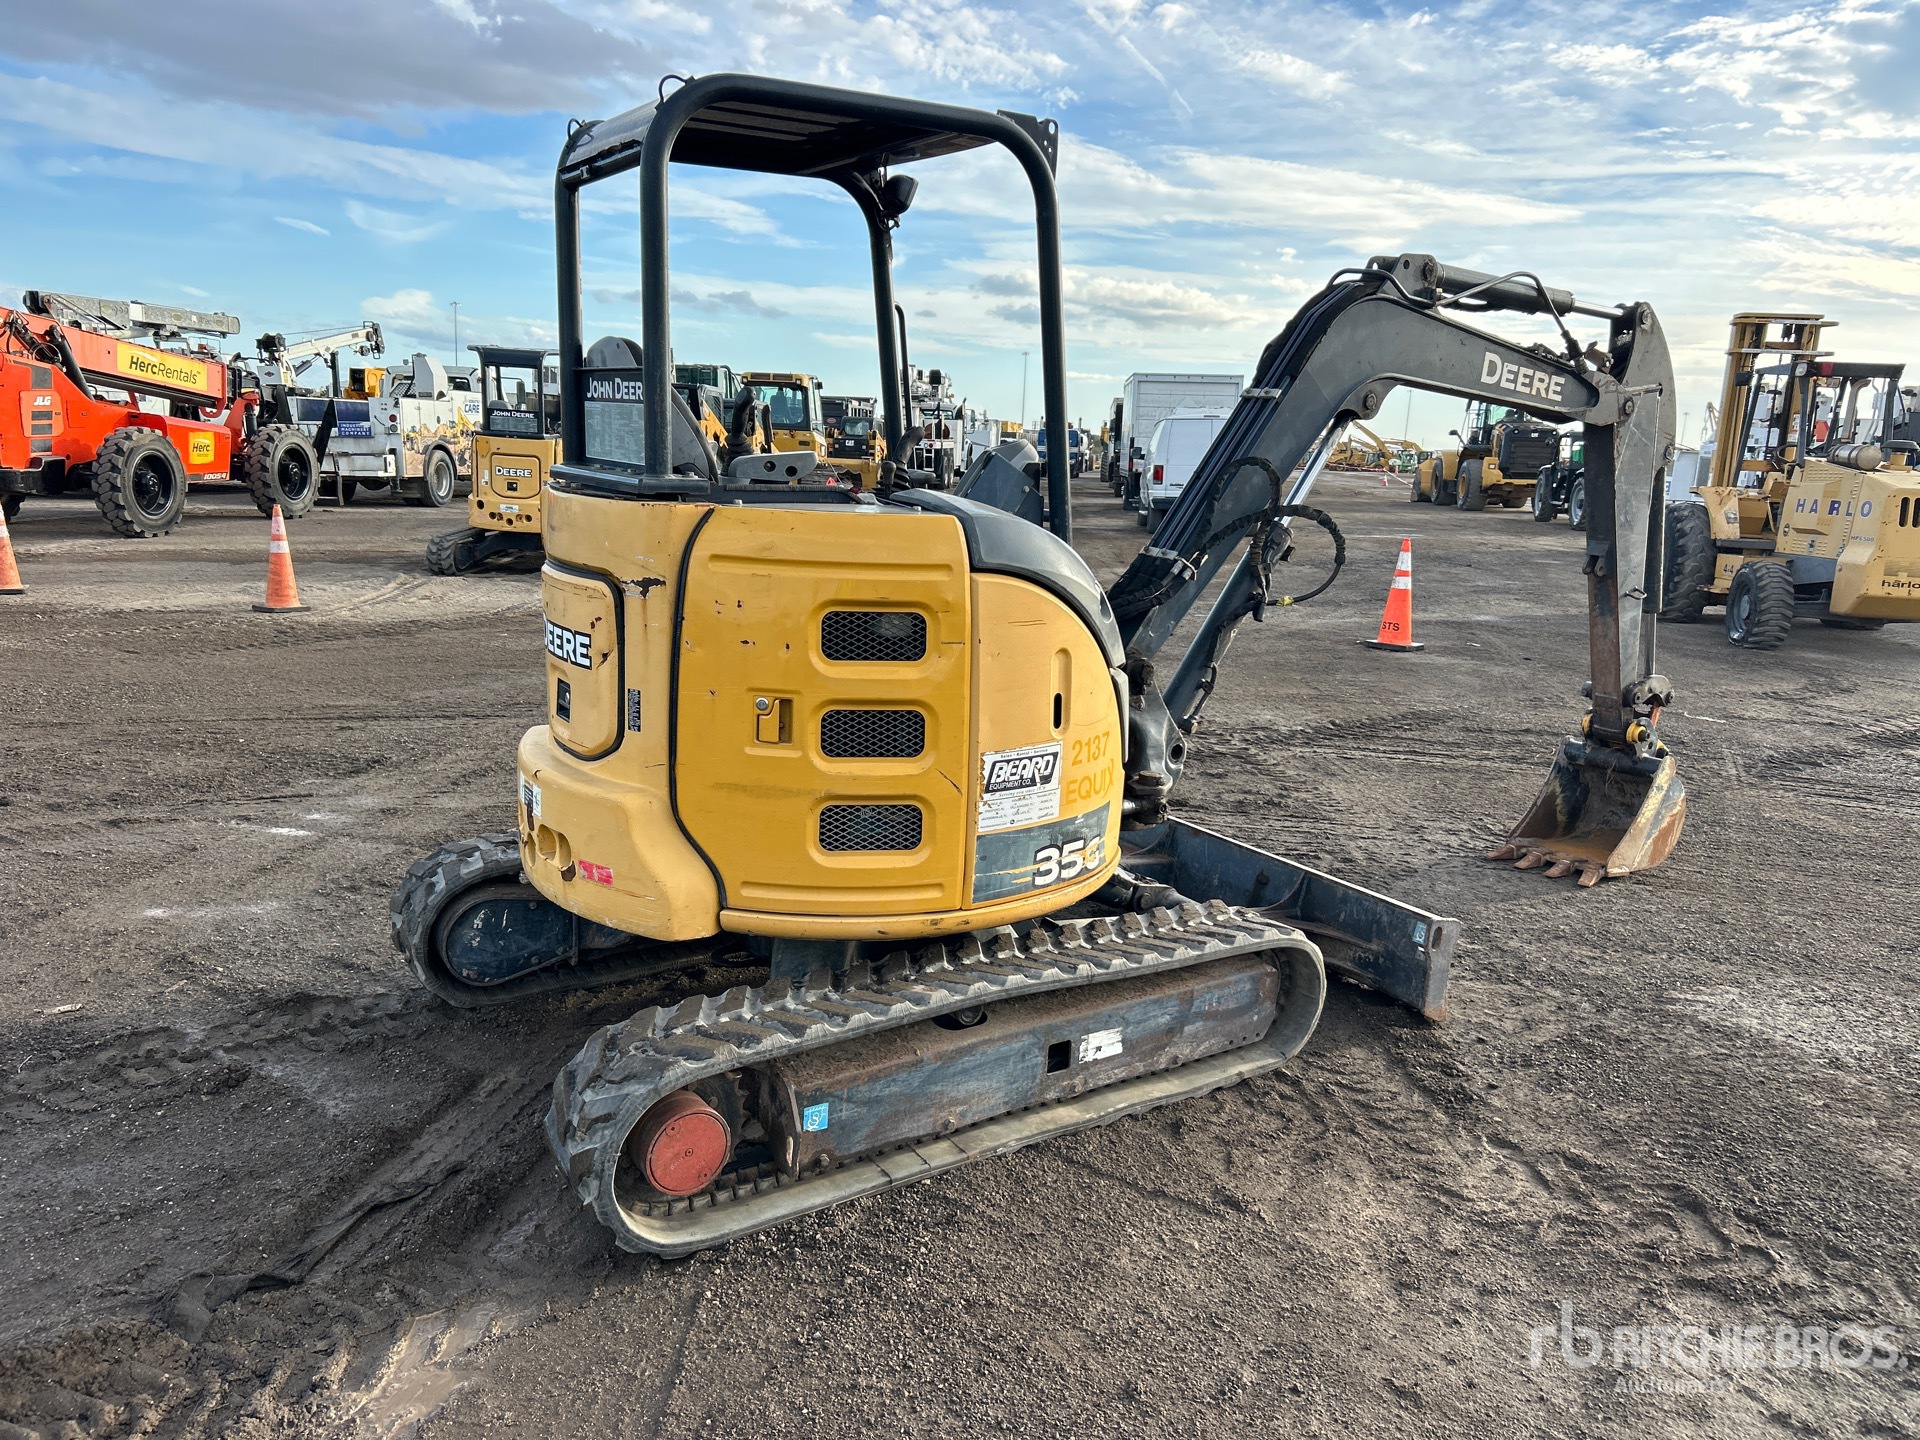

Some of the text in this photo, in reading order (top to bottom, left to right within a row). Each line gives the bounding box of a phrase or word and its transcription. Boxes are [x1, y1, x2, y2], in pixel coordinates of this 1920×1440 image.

[1480, 351, 1566, 402] DEERE
[586, 377, 644, 400] JOHN DEER
[33, 395, 52, 406] JLG
[464, 403, 480, 414] CARE
[492, 409, 535, 419] JOHN DEERE
[192, 443, 211, 453] Herc
[495, 466, 533, 478] DEERE
[1794, 498, 1873, 519] HARLO
[1381, 621, 1401, 632] STS
[1071, 730, 1111, 767] 2137
[989, 754, 1054, 784] BEARD
[988, 778, 1032, 791] EQUIPMENT CO.
